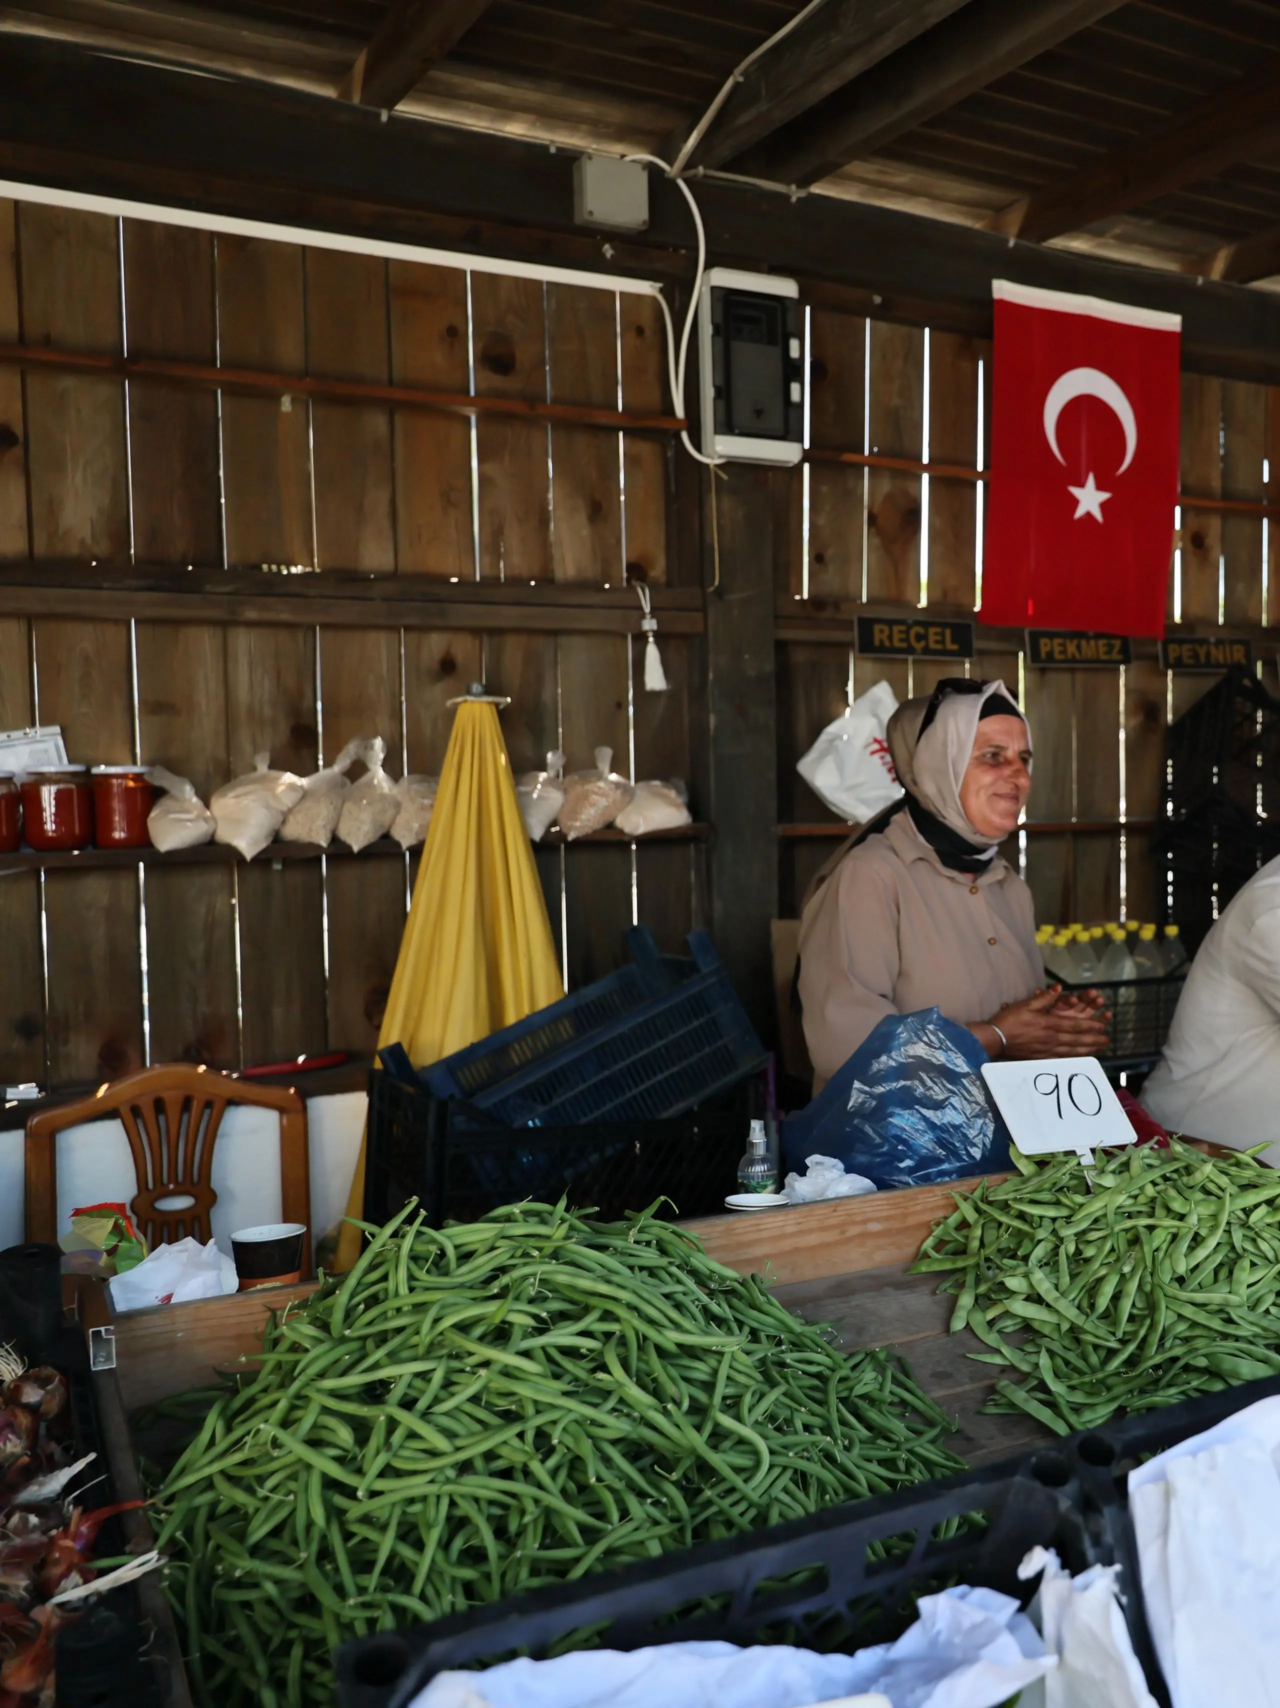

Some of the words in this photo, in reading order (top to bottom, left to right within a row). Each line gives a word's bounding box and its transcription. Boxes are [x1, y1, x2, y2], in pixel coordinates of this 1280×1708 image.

[872, 623, 959, 653] REÇEL
[1039, 638, 1123, 661] PEKMEZ
[1168, 643, 1246, 665] PEYNİR
[1034, 1073, 1102, 1120] 90
